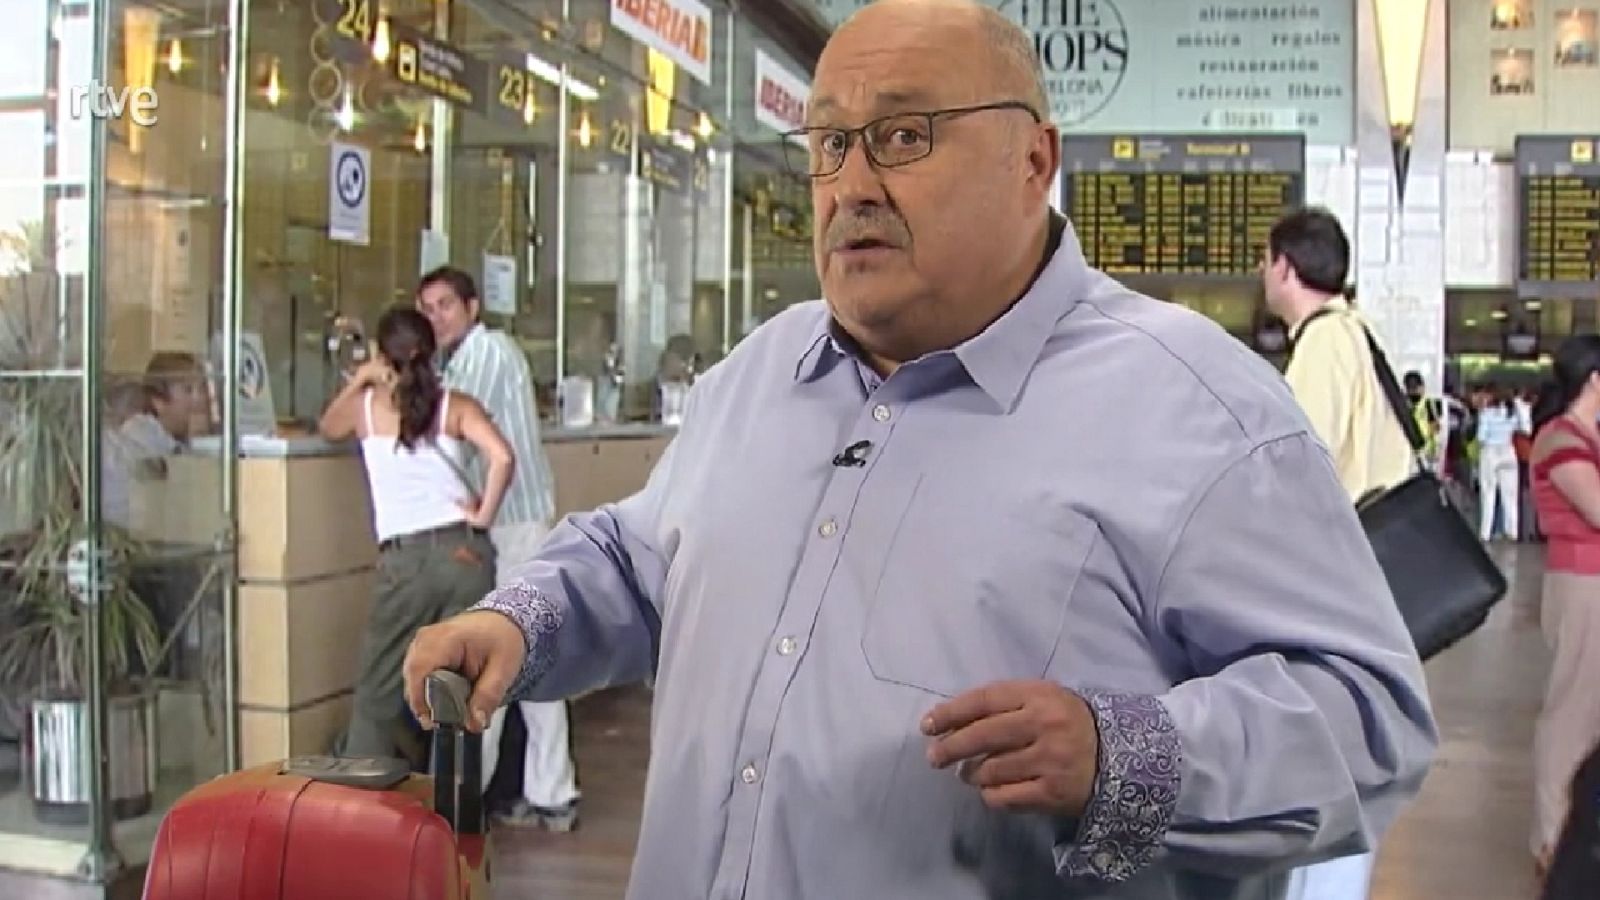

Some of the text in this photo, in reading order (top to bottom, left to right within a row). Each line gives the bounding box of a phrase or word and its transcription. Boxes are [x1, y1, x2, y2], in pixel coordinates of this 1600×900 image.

[336, 0, 369, 45] 24
[616, 0, 691, 50] BERIA
[1021, 0, 1100, 26] THE
[1035, 31, 1128, 71] OPS
[1272, 30, 1340, 47] regalos
[500, 65, 524, 110] 23
[1288, 82, 1343, 97] libros
